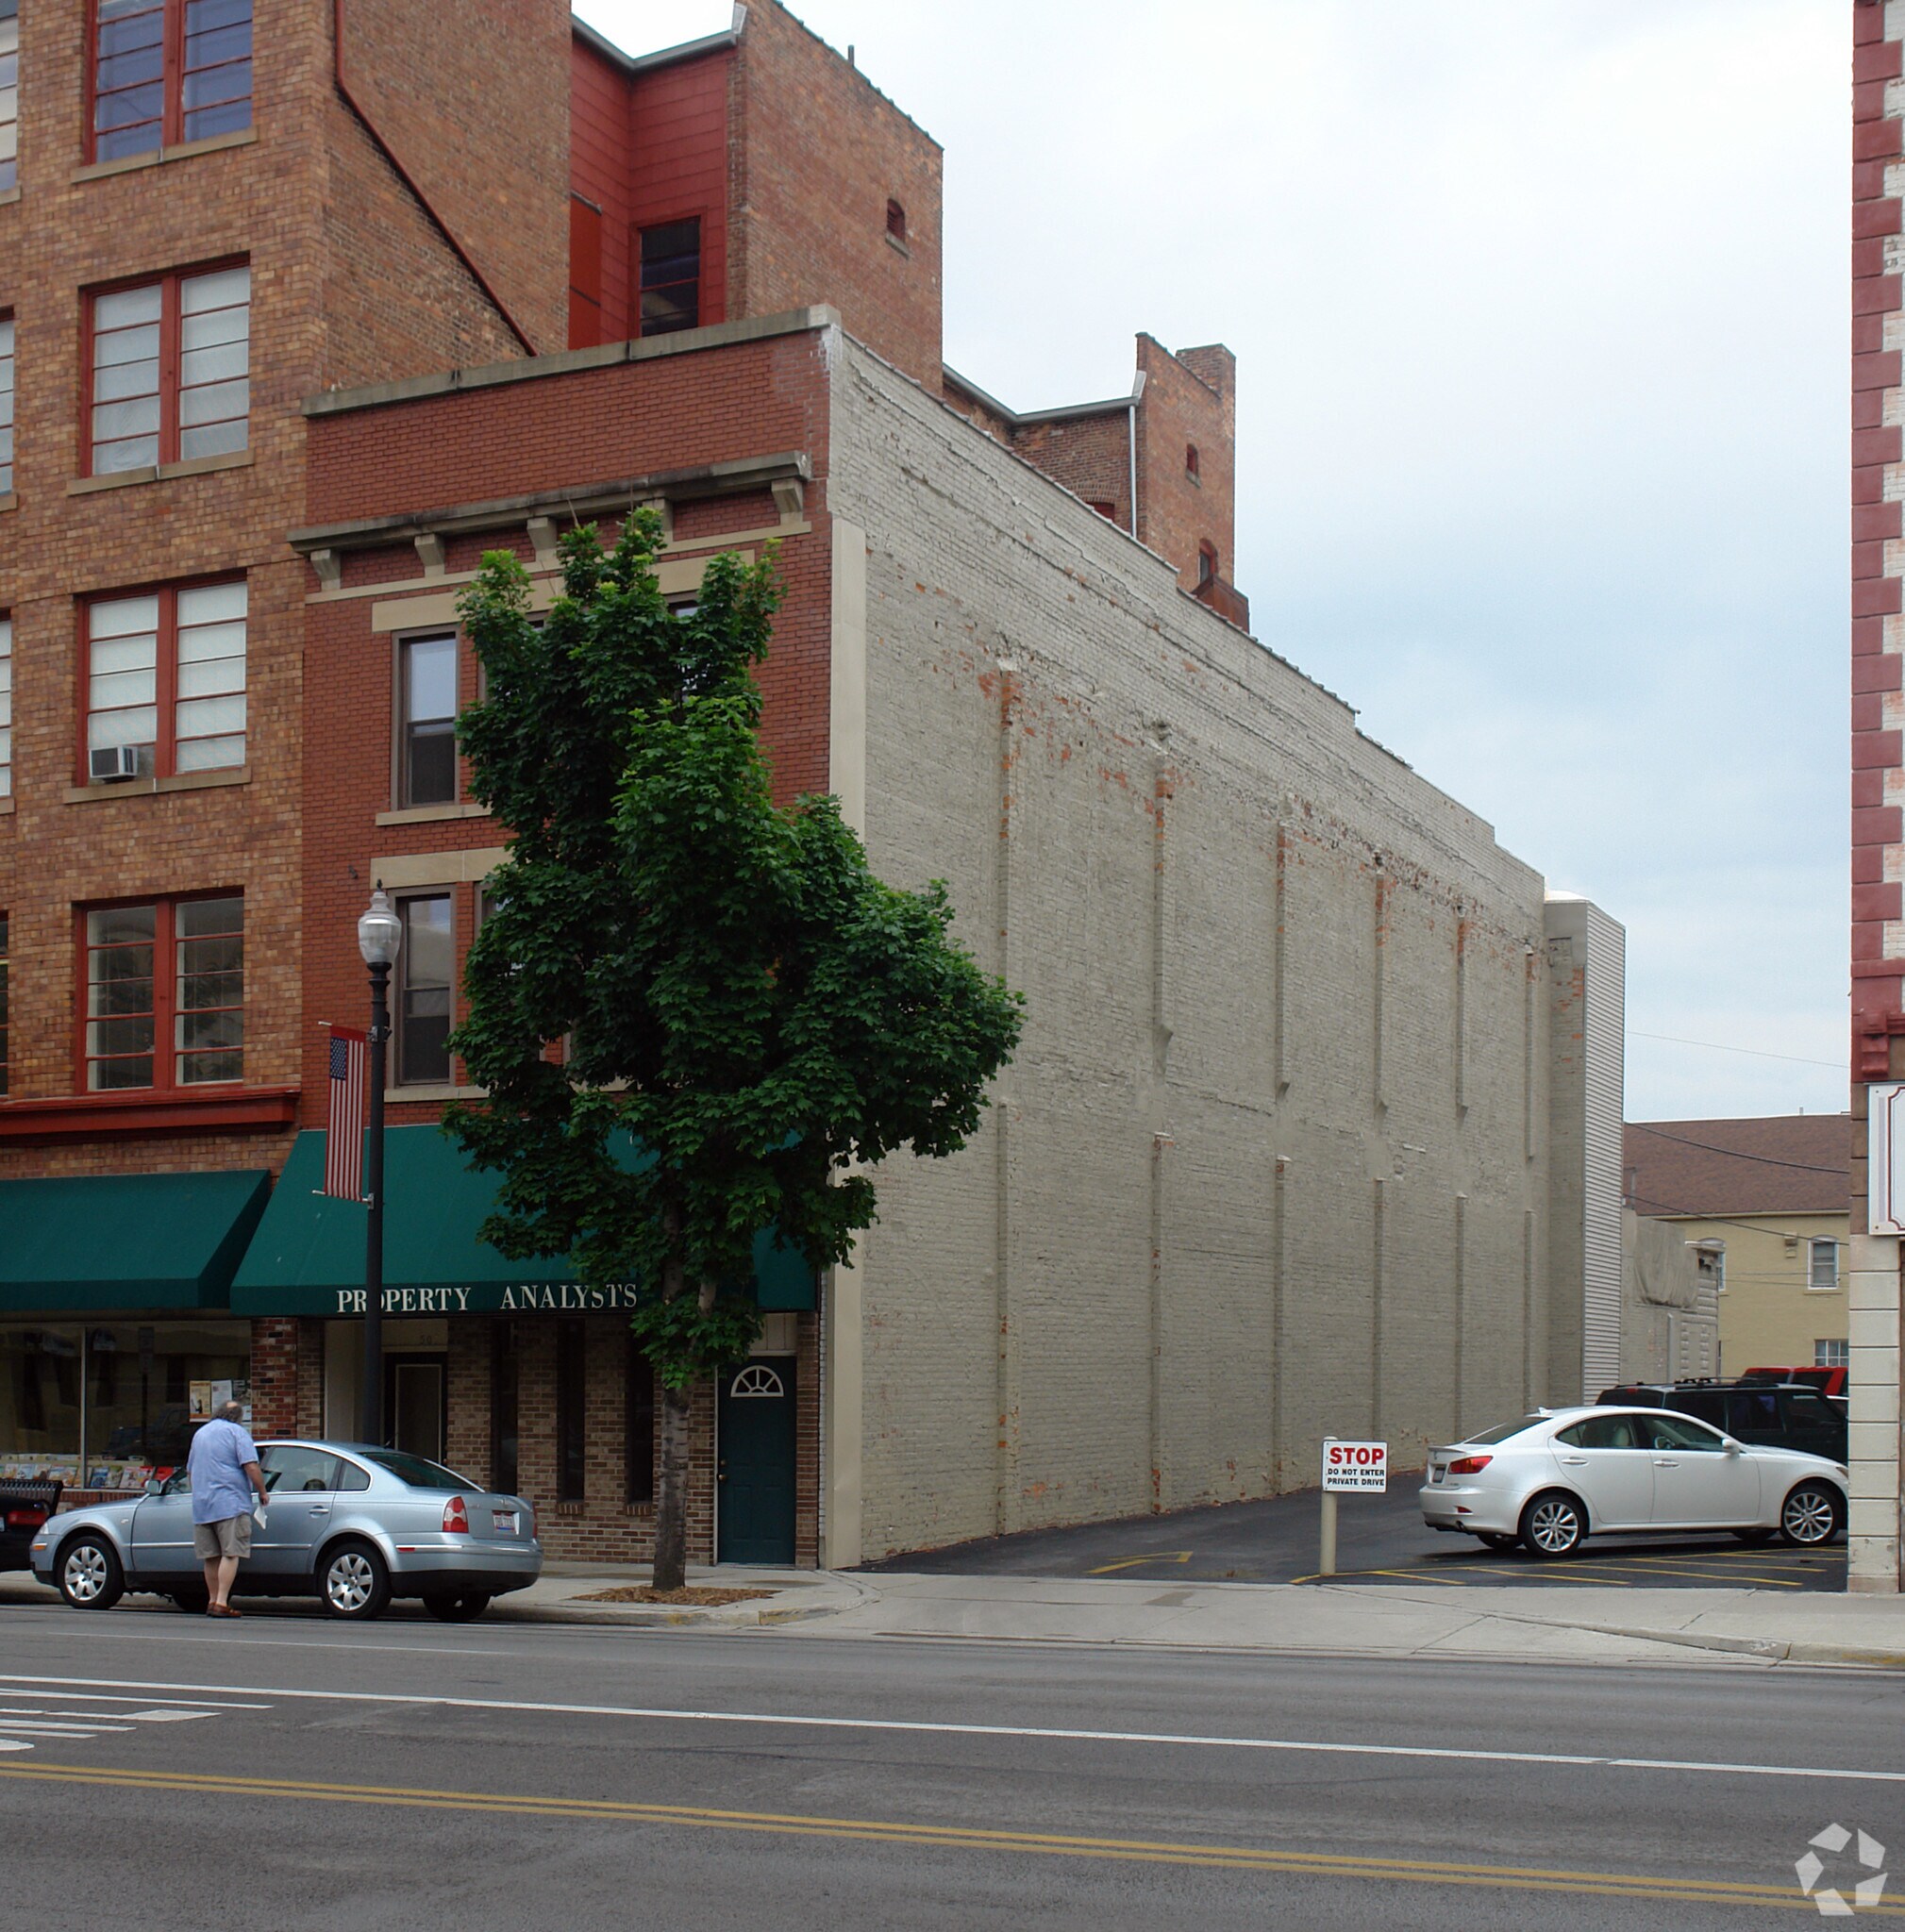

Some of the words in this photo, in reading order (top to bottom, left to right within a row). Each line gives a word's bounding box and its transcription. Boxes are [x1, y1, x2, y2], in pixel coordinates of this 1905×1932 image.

[336, 1287, 472, 1313] PRPERTY
[499, 1283, 638, 1309] ANALYSTS
[1329, 1446, 1384, 1465] STOP
[1342, 1468, 1358, 1476] NOT
[1327, 1477, 1359, 1486] PRIVATE
[1362, 1478, 1384, 1487] DRIVE
